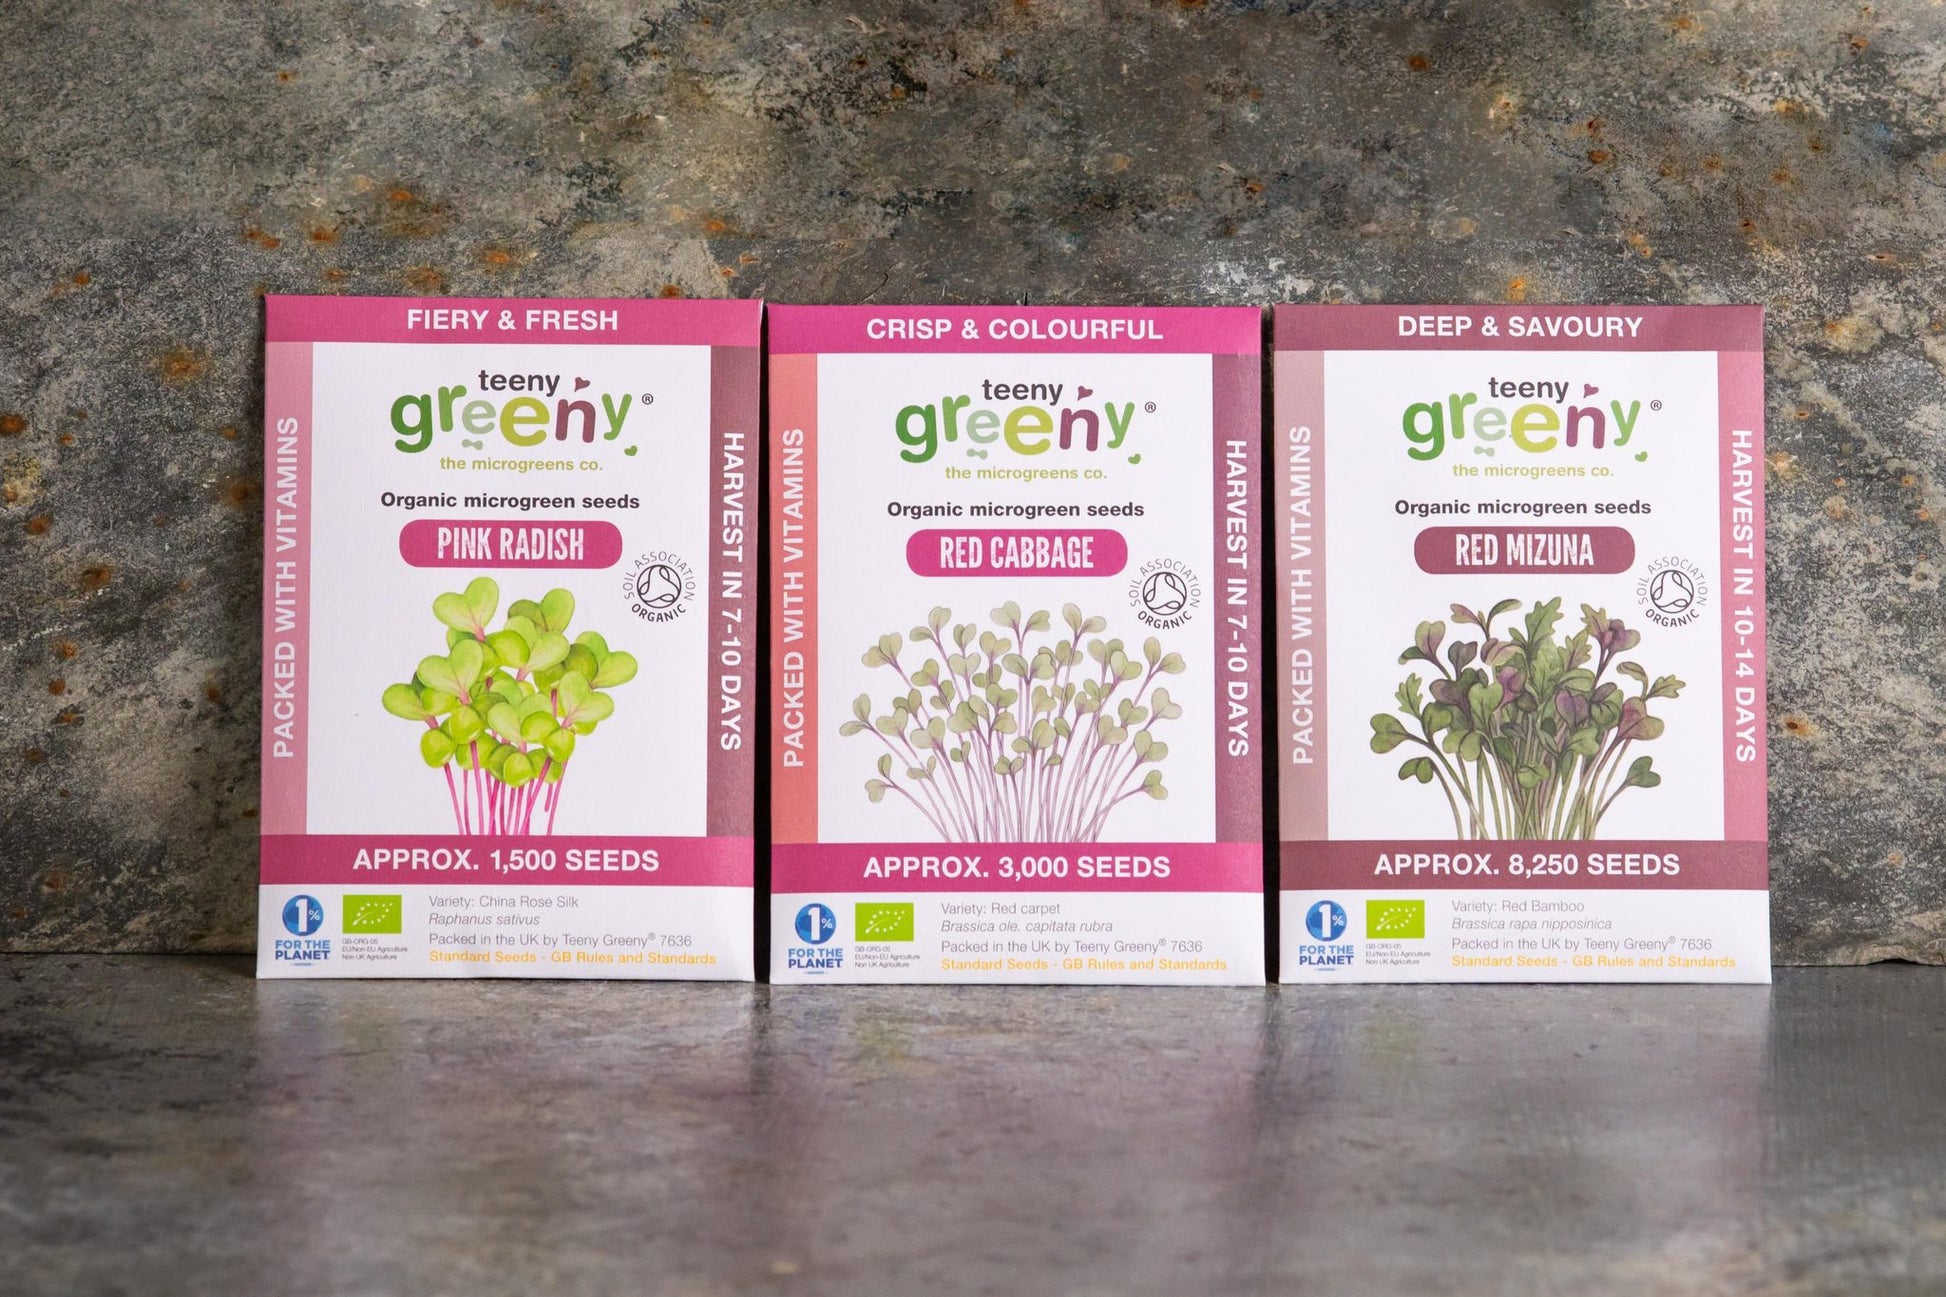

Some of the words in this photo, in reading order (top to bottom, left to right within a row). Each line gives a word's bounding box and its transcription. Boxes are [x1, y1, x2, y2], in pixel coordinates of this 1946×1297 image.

[408, 309, 489, 329] FIERY
[498, 310, 516, 330] &
[527, 310, 617, 330] FRESH
[867, 319, 951, 339] CRISP
[962, 319, 979, 339] &
[989, 319, 1163, 339] COLOURFUL
[1399, 316, 1472, 336] DEEP
[1482, 316, 1499, 336] &
[1509, 316, 1643, 337] SAVOURY
[479, 370, 560, 397] teeny
[982, 379, 1063, 406] teeny
[1488, 377, 1569, 403] teeny
[440, 457, 466, 469] the
[472, 457, 574, 473] microgreens
[580, 461, 602, 470] co.
[945, 466, 971, 479] the
[977, 466, 1078, 482] microgreens
[1084, 470, 1106, 479] co.
[1453, 464, 1478, 476] the
[1485, 464, 1585, 479] microgreens
[1591, 467, 1613, 476] co.
[277, 418, 298, 552] VITAMINS
[720, 433, 744, 562] HARVEST
[783, 429, 803, 562] VITAMINS
[1290, 426, 1311, 560] VITAMINS
[1733, 431, 1753, 559] HARVEST
[381, 492, 456, 510] Organic
[465, 493, 575, 511] microgreen
[583, 494, 639, 508] seeds
[888, 502, 962, 519] Organic
[971, 502, 1080, 519] microgreen
[1088, 502, 1144, 516] seeds
[1225, 441, 1247, 569] HARVEST
[1395, 500, 1470, 517] Organic
[1478, 500, 1587, 517] microgreen
[1595, 500, 1651, 514] seeds
[438, 527, 491, 559] PINK
[500, 528, 583, 560] RADISH
[941, 537, 982, 568] RED
[991, 536, 1093, 568] CABBAGE
[1456, 534, 1498, 565] RED
[1507, 534, 1594, 565] MIZUNA
[623, 565, 635, 600] SOIL
[633, 551, 697, 602] ASSOCIATION
[723, 572, 742, 598] IN
[1129, 573, 1142, 607] SOIL
[1139, 559, 1202, 609] ASSOCIATION
[1636, 570, 1648, 605] SOIL
[1646, 555, 1709, 607] ASSOCIATION
[1734, 569, 1753, 594] IN
[275, 562, 296, 632] WITH
[1228, 579, 1247, 604] IN
[632, 603, 686, 623] ORGANIC
[784, 572, 803, 642] WITH
[1290, 570, 1312, 639] WITH
[1137, 610, 1193, 630] ORGANIC
[1645, 608, 1700, 627] ORGANIC
[722, 609, 741, 665] 7-10
[1228, 615, 1247, 672] 7-10
[1735, 606, 1754, 677] 10-14
[274, 642, 294, 757] PACKED
[784, 652, 804, 766] PACKED
[1292, 648, 1313, 766] PACKED
[721, 676, 741, 750] DAYS
[1227, 682, 1248, 756] DAYS
[1736, 688, 1755, 761] DAYS
[353, 849, 478, 870] APPROX.
[491, 850, 556, 874] 1,500
[566, 849, 659, 871] SEEDS
[864, 856, 988, 877] APPROX.
[999, 857, 1068, 881] 3,000
[1077, 856, 1170, 877] SEEDS
[1374, 854, 1499, 875] APPROX.
[1509, 854, 1578, 878] 8,250
[1588, 854, 1679, 875] SEEDS
[429, 896, 474, 909] Variety:
[480, 896, 515, 907] China
[521, 896, 552, 907] Rose
[557, 896, 578, 907] Silk
[941, 903, 986, 916] Variety:
[992, 903, 1016, 914] Red
[1021, 904, 1060, 916] carpet
[1452, 900, 1496, 914] Variety:
[1502, 900, 1526, 912] Red
[1532, 900, 1584, 912] Bamboo
[429, 913, 492, 926] Raphanus
[497, 914, 540, 925] sativus
[941, 920, 994, 932] Brassica
[1026, 920, 1075, 933] capitata
[1080, 921, 1112, 932] rubra
[1452, 918, 1505, 929] Brassica
[1510, 920, 1537, 931] rapa
[275, 940, 302, 950] FOR
[305, 940, 330, 950] THE
[429, 934, 476, 946] Packed
[481, 934, 491, 945] in
[496, 934, 515, 945] the
[520, 934, 539, 945] UK
[543, 934, 558, 947] by
[563, 934, 598, 948] Teeny
[661, 935, 691, 946] 7636
[788, 948, 814, 958] FOR
[818, 948, 843, 958] THE
[942, 941, 988, 952] Packed
[993, 941, 1003, 952] in
[1008, 941, 1027, 952] the
[1032, 941, 1050, 952] UK
[1055, 941, 1069, 954] by
[1074, 941, 1109, 954] Teeny
[1171, 941, 1202, 952] 7636
[1299, 945, 1325, 955] FOR
[1328, 945, 1354, 955] THE
[1452, 938, 1498, 949] Packed
[1503, 938, 1513, 949] in
[1518, 938, 1537, 949] the
[1542, 938, 1560, 949] UK
[1565, 938, 1580, 952] by
[1585, 938, 1619, 952] Teeny
[1681, 939, 1712, 950] 7636
[275, 950, 330, 960] PLANET
[429, 949, 490, 962] Standard
[495, 950, 537, 962] Seeds
[551, 951, 572, 963] GB
[577, 951, 613, 963] Rules
[618, 951, 643, 963] and
[648, 951, 716, 964] Standards
[788, 959, 843, 968] PLANET
[942, 959, 1002, 970] Standard
[1007, 959, 1048, 970] Seeds
[1063, 959, 1083, 970] GB
[1088, 958, 1124, 970] Rules
[1130, 959, 1154, 970] and
[1159, 959, 1226, 970] Standards
[1299, 955, 1354, 965] PLANET
[1452, 955, 1512, 967] Standard
[1517, 955, 1557, 967] Seeds
[1573, 955, 1592, 967] GB
[1598, 955, 1634, 967] Rules
[1639, 955, 1663, 967] and
[1668, 955, 1735, 967] Standards
